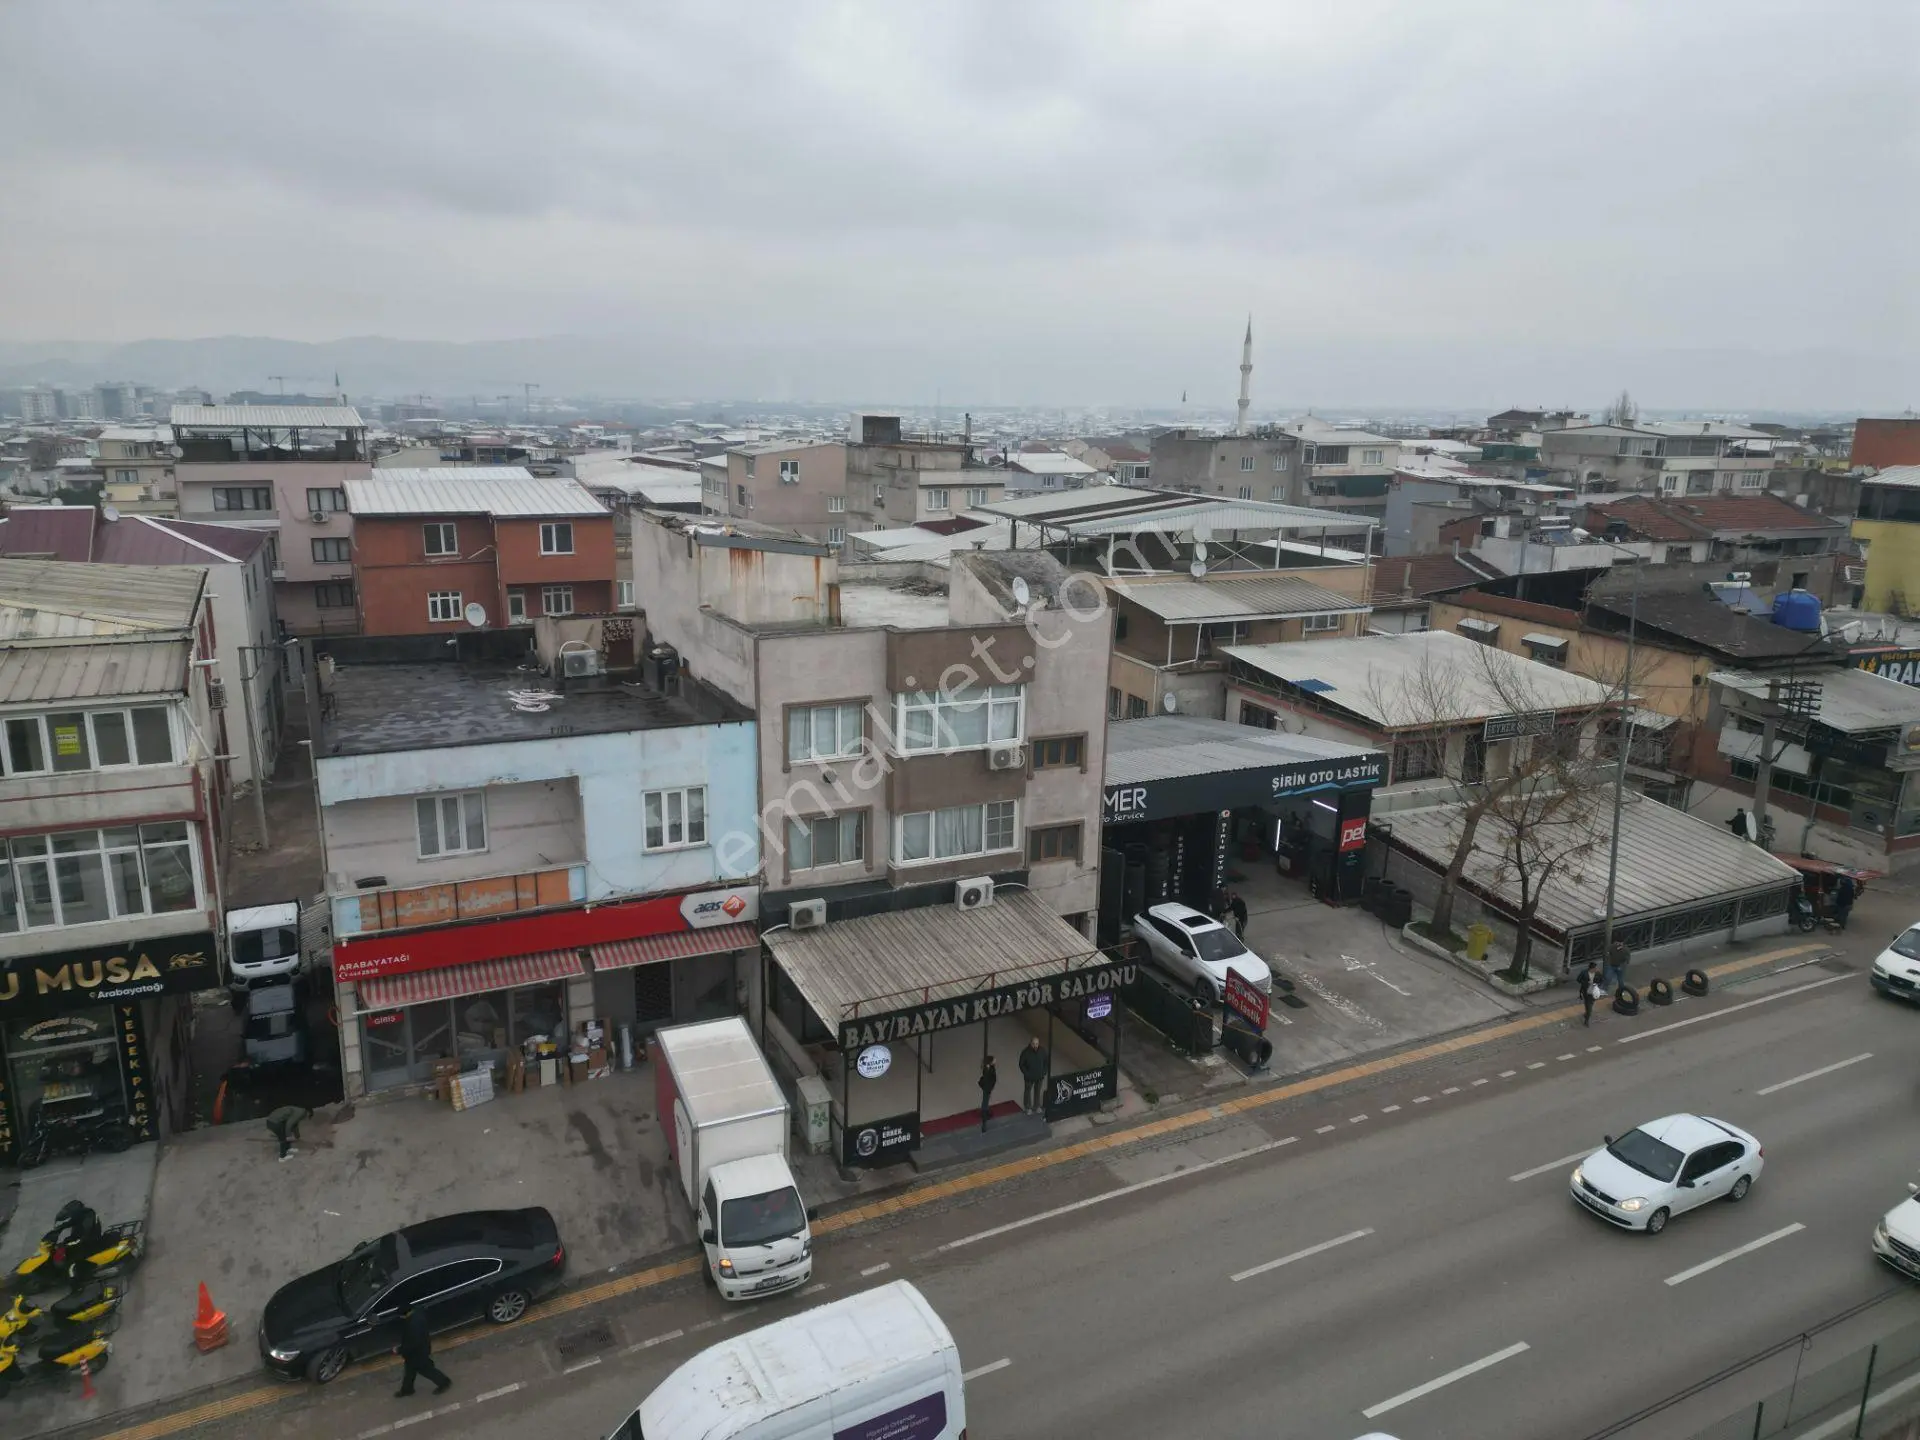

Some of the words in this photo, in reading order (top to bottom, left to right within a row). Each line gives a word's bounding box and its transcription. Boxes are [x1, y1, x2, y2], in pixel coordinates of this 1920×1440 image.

[1272, 772, 1305, 791] ŞİRİN
[1310, 770, 1334, 784] OTO
[1337, 764, 1380, 780] LASTİK
[1114, 811, 1145, 822] Service
[35, 953, 161, 995] MUSA
[339, 954, 410, 972] ARABAYATAĞI
[97, 983, 164, 999] Arabayatağı
[844, 1002, 968, 1049] BAY/BAYAN
[973, 982, 1052, 1021] KUAFÖR
[1059, 964, 1137, 999] SALONU
[122, 1007, 141, 1070] YEDEK
